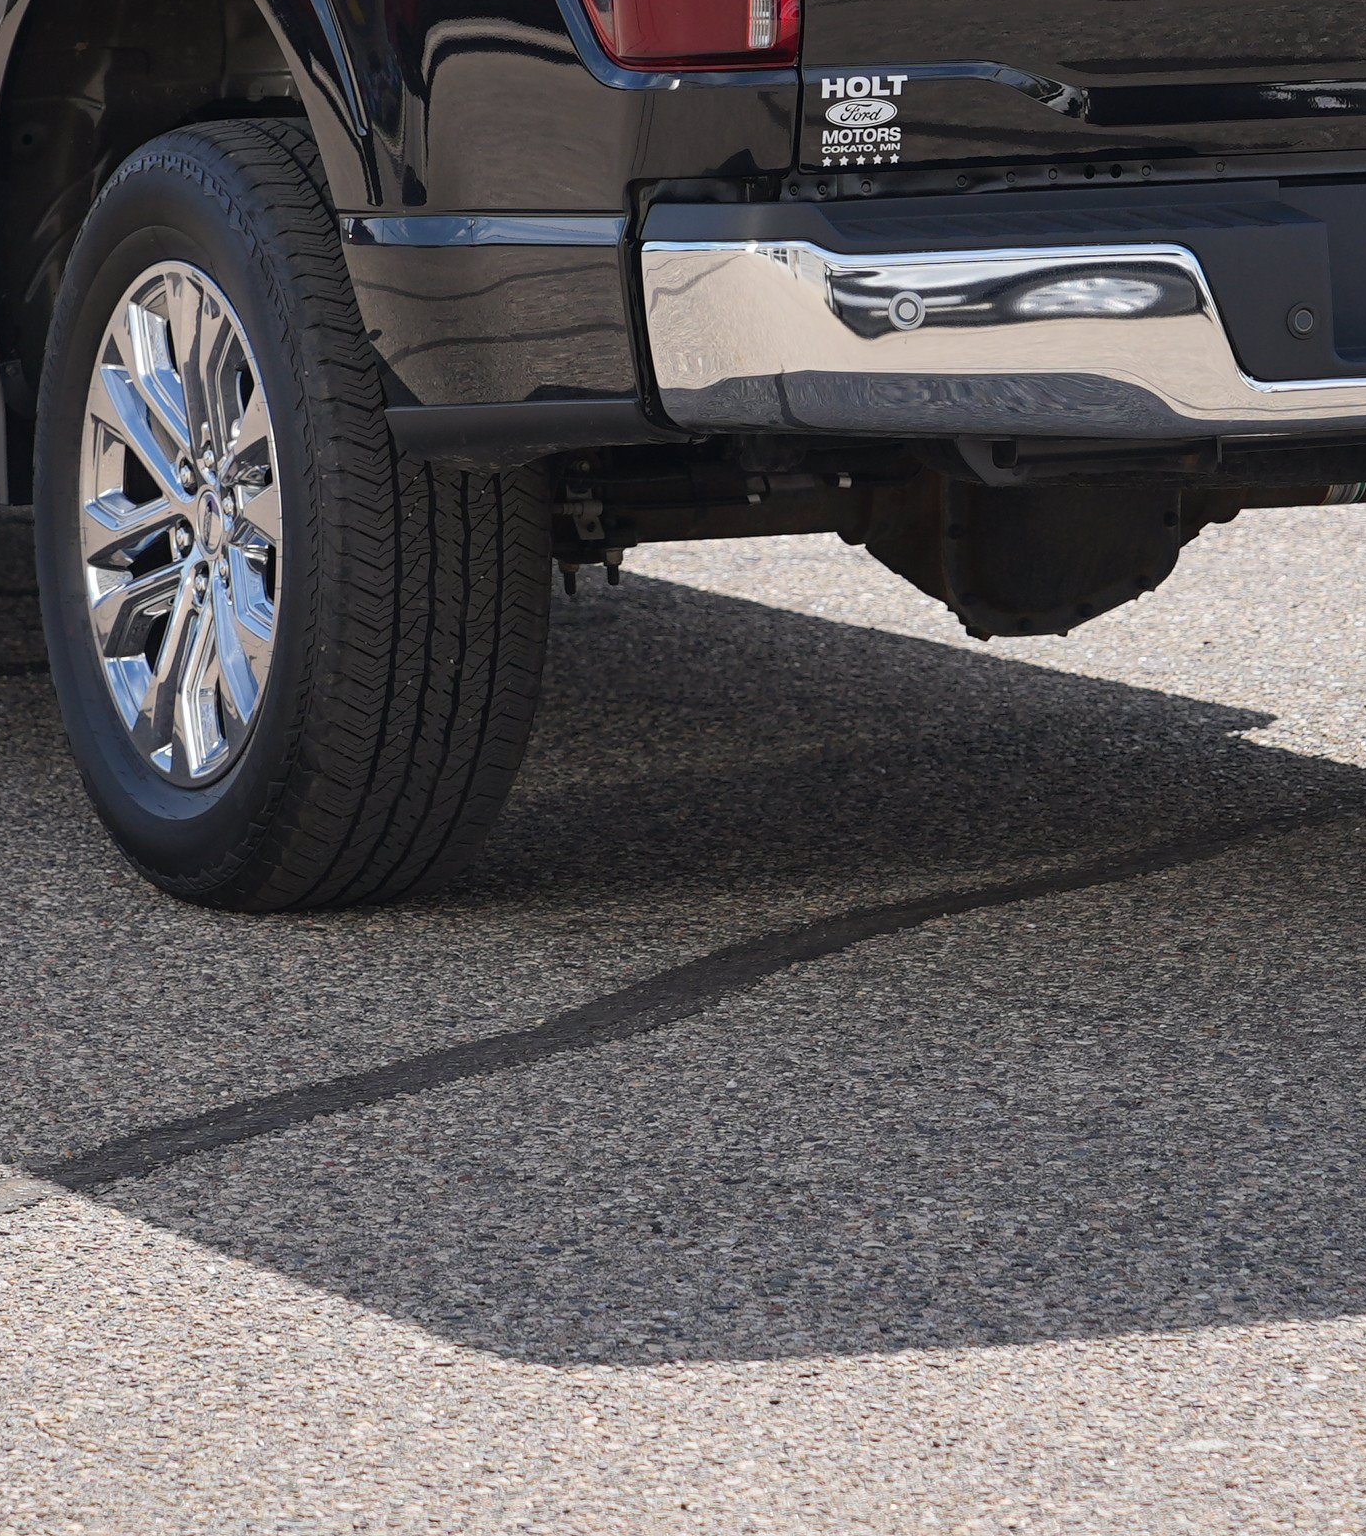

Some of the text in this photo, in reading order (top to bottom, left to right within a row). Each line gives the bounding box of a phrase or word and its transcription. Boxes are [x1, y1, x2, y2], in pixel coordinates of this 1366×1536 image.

[821, 75, 908, 99] HOLT
[840, 103, 883, 122] Ford
[822, 126, 902, 145] MOTORS
[821, 142, 901, 154] COKATO, MN
